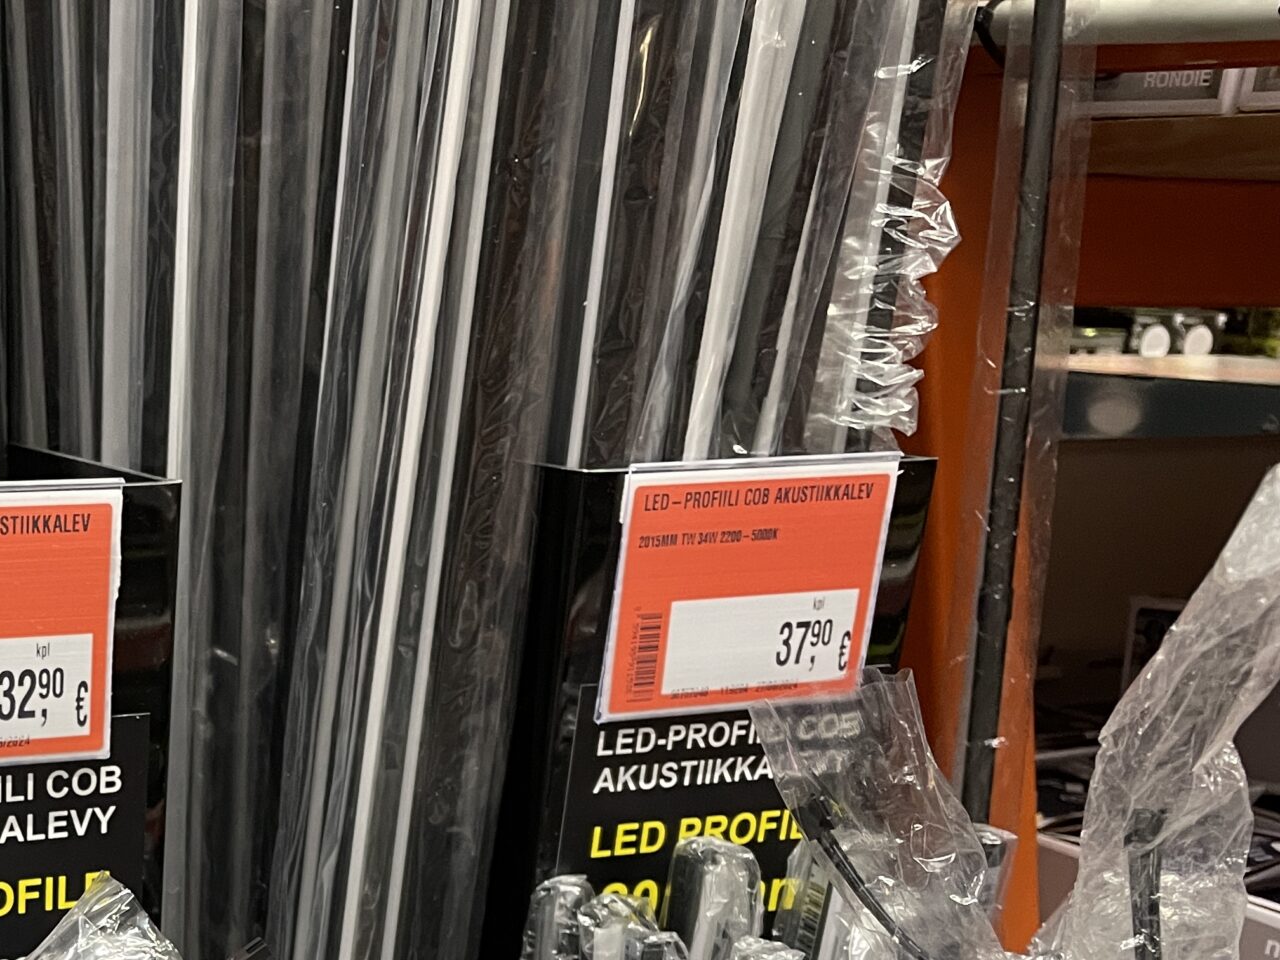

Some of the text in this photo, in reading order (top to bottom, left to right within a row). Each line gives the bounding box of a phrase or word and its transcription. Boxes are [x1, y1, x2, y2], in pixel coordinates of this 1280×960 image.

[1143, 69, 1214, 88] RONDIE
[744, 487, 769, 506] COB
[774, 482, 874, 505] AKUSTIIKKALEV
[638, 534, 678, 548] 2015MM
[36, 642, 50, 658] kpl
[75, 680, 89, 727] €
[46, 765, 122, 799] COB
[592, 756, 774, 795] AKUSTIIKKA
[590, 809, 804, 859] LED PROFIL
